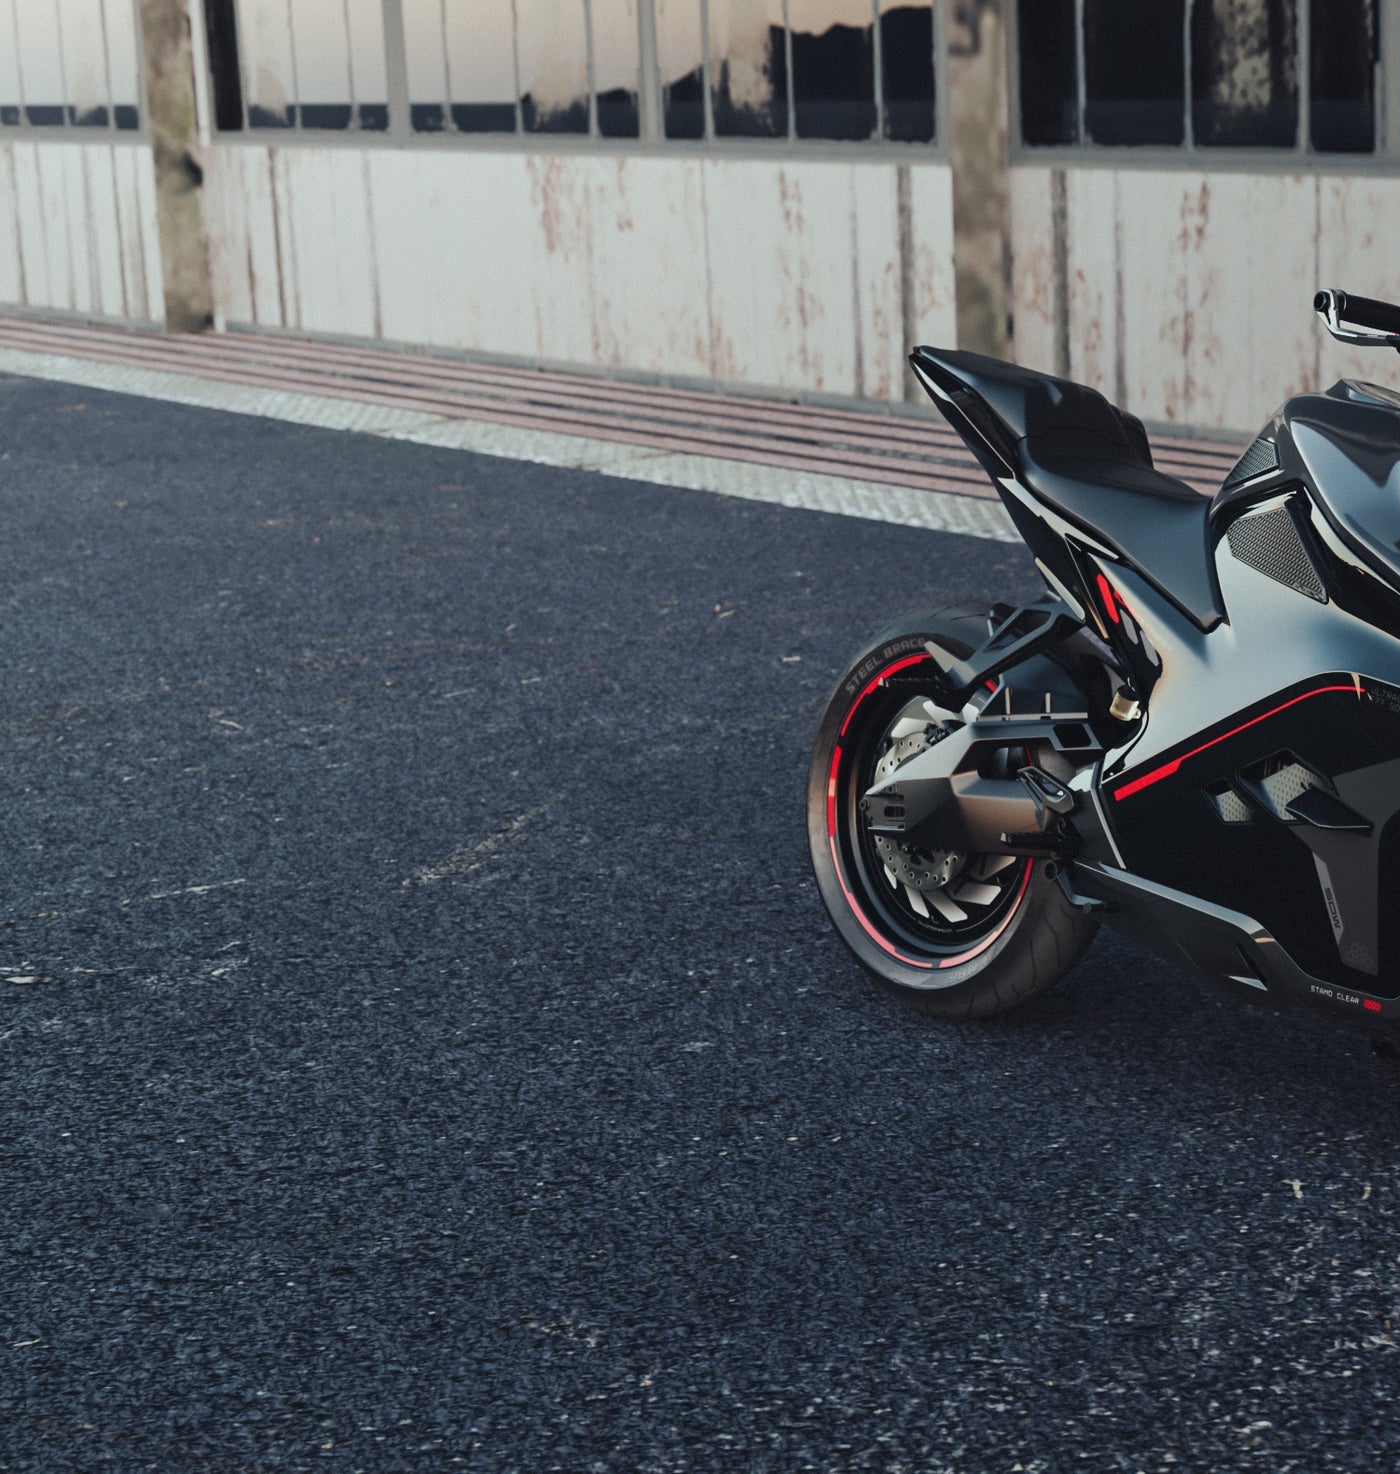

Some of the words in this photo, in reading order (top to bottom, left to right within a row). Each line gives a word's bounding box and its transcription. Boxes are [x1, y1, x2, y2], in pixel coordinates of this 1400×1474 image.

[845, 656, 881, 694] STEEL
[883, 638, 925, 658] BRACE
[1310, 985, 1333, 998] STAND
[1336, 992, 1360, 1004] CLEAR
